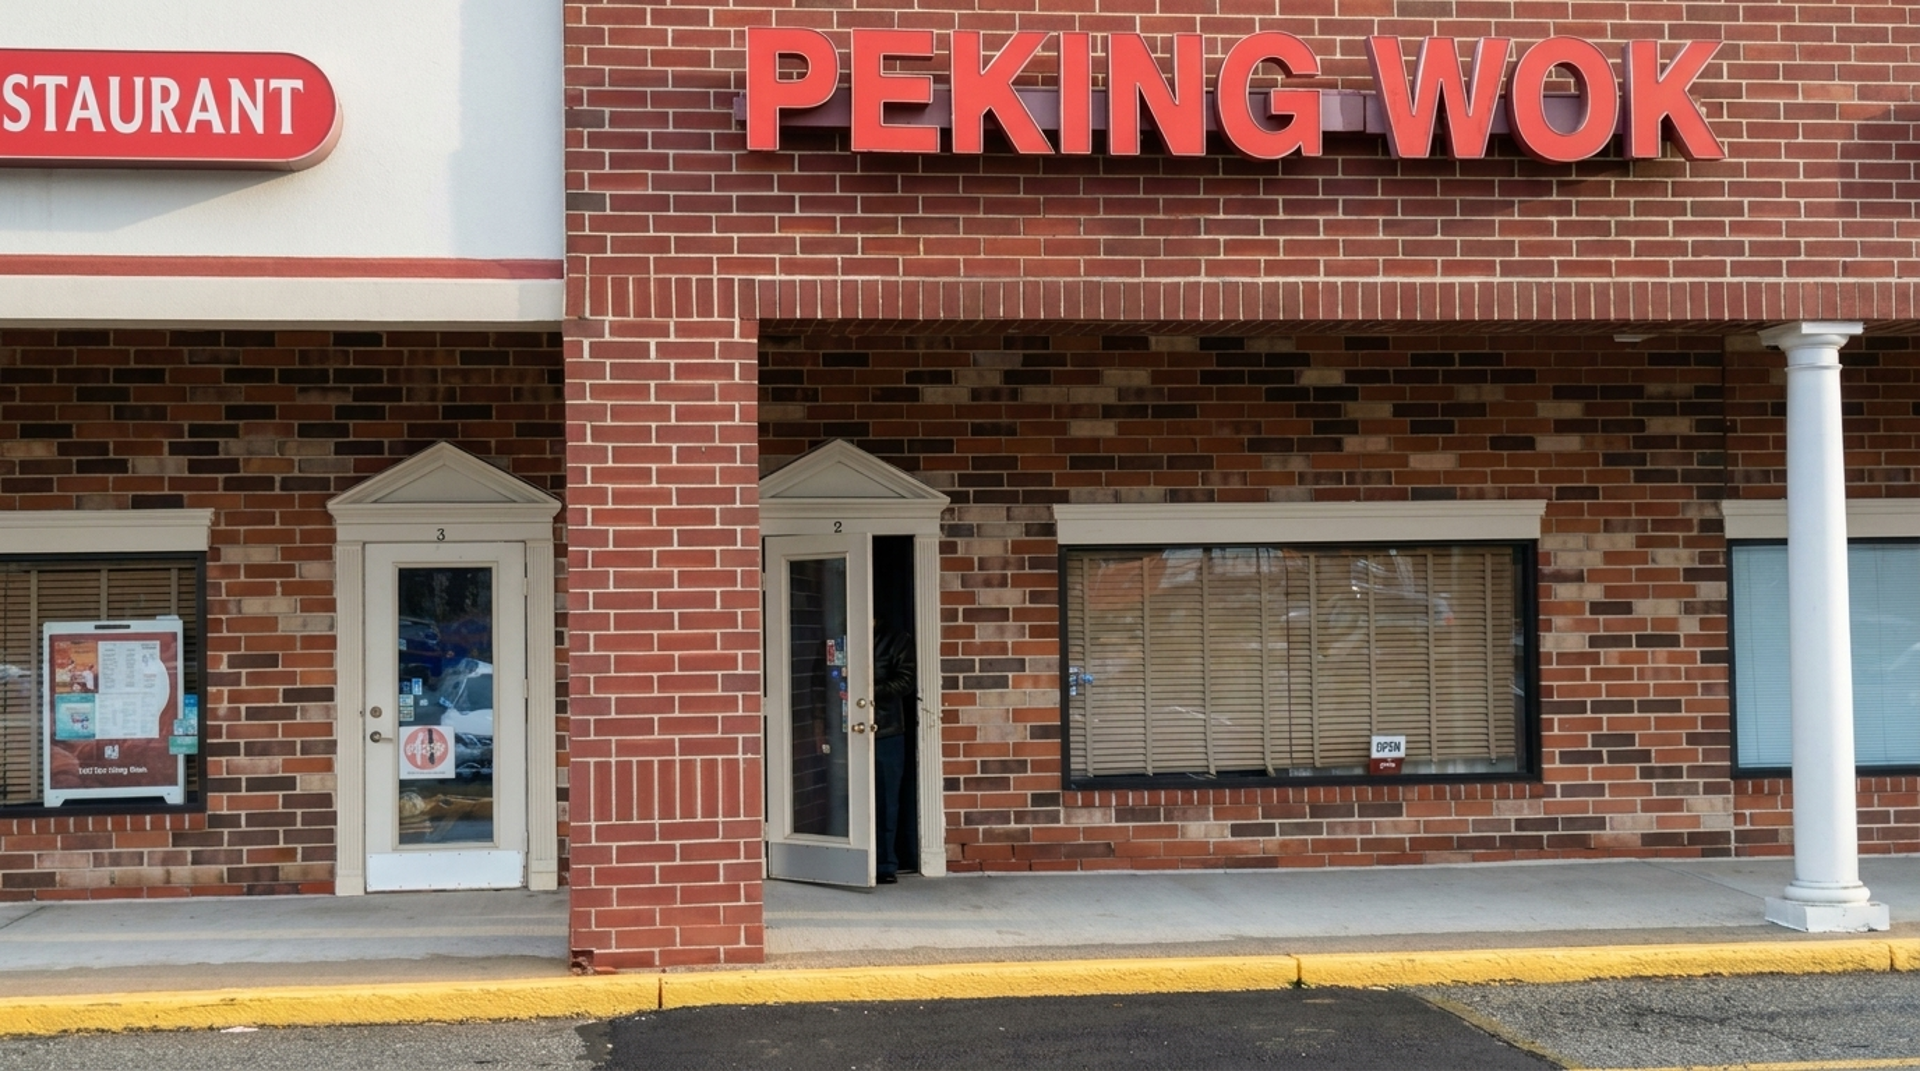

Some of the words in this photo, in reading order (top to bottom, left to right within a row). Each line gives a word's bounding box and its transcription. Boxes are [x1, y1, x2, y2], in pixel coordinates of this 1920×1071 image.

[2, 73, 304, 135] STAURANT
[745, 26, 1322, 161] PEKING
[1365, 35, 1726, 165] WOK
[436, 528, 446, 542] 3
[834, 520, 843, 534] 2
